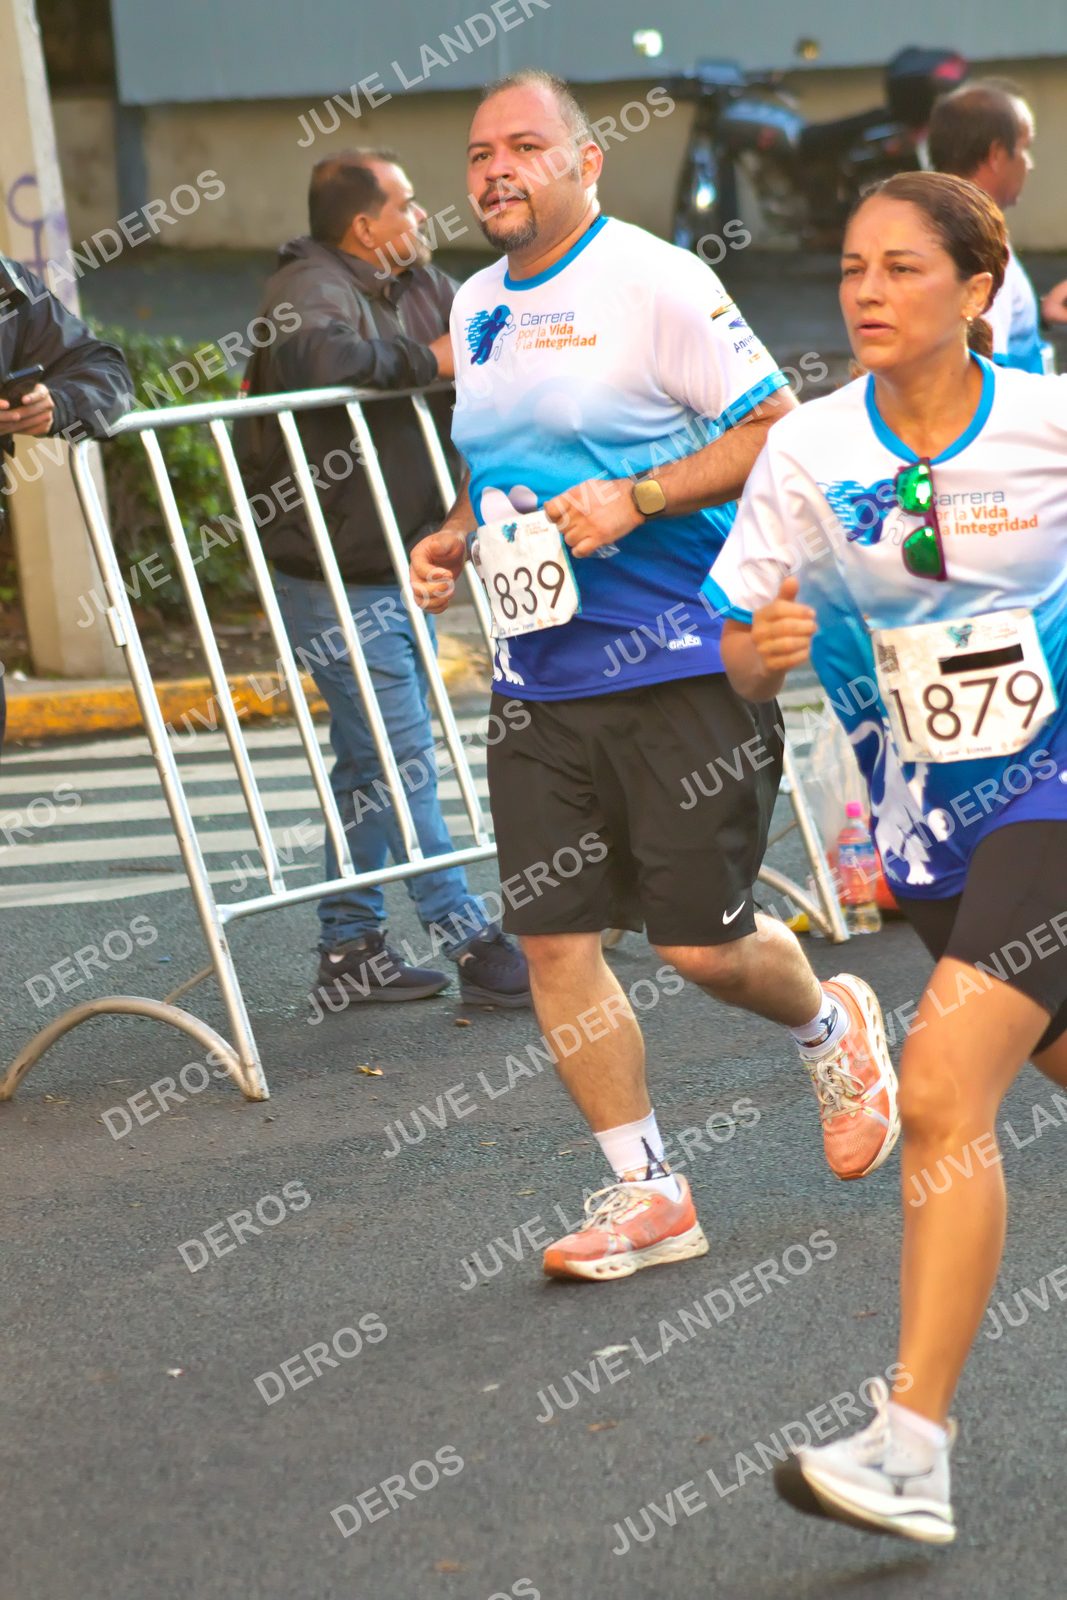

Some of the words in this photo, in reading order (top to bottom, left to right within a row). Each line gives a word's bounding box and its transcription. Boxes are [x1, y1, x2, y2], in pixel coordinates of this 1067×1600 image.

[520, 311, 575, 326] Carrera
[517, 328, 536, 341] por
[537, 326, 547, 337] la
[549, 323, 574, 336] Vida
[535, 334, 597, 351] Integridad
[954, 509, 967, 521] la
[971, 506, 1008, 520] Vida
[955, 515, 1039, 537] Integridad
[889, 670, 1043, 742] 1879
